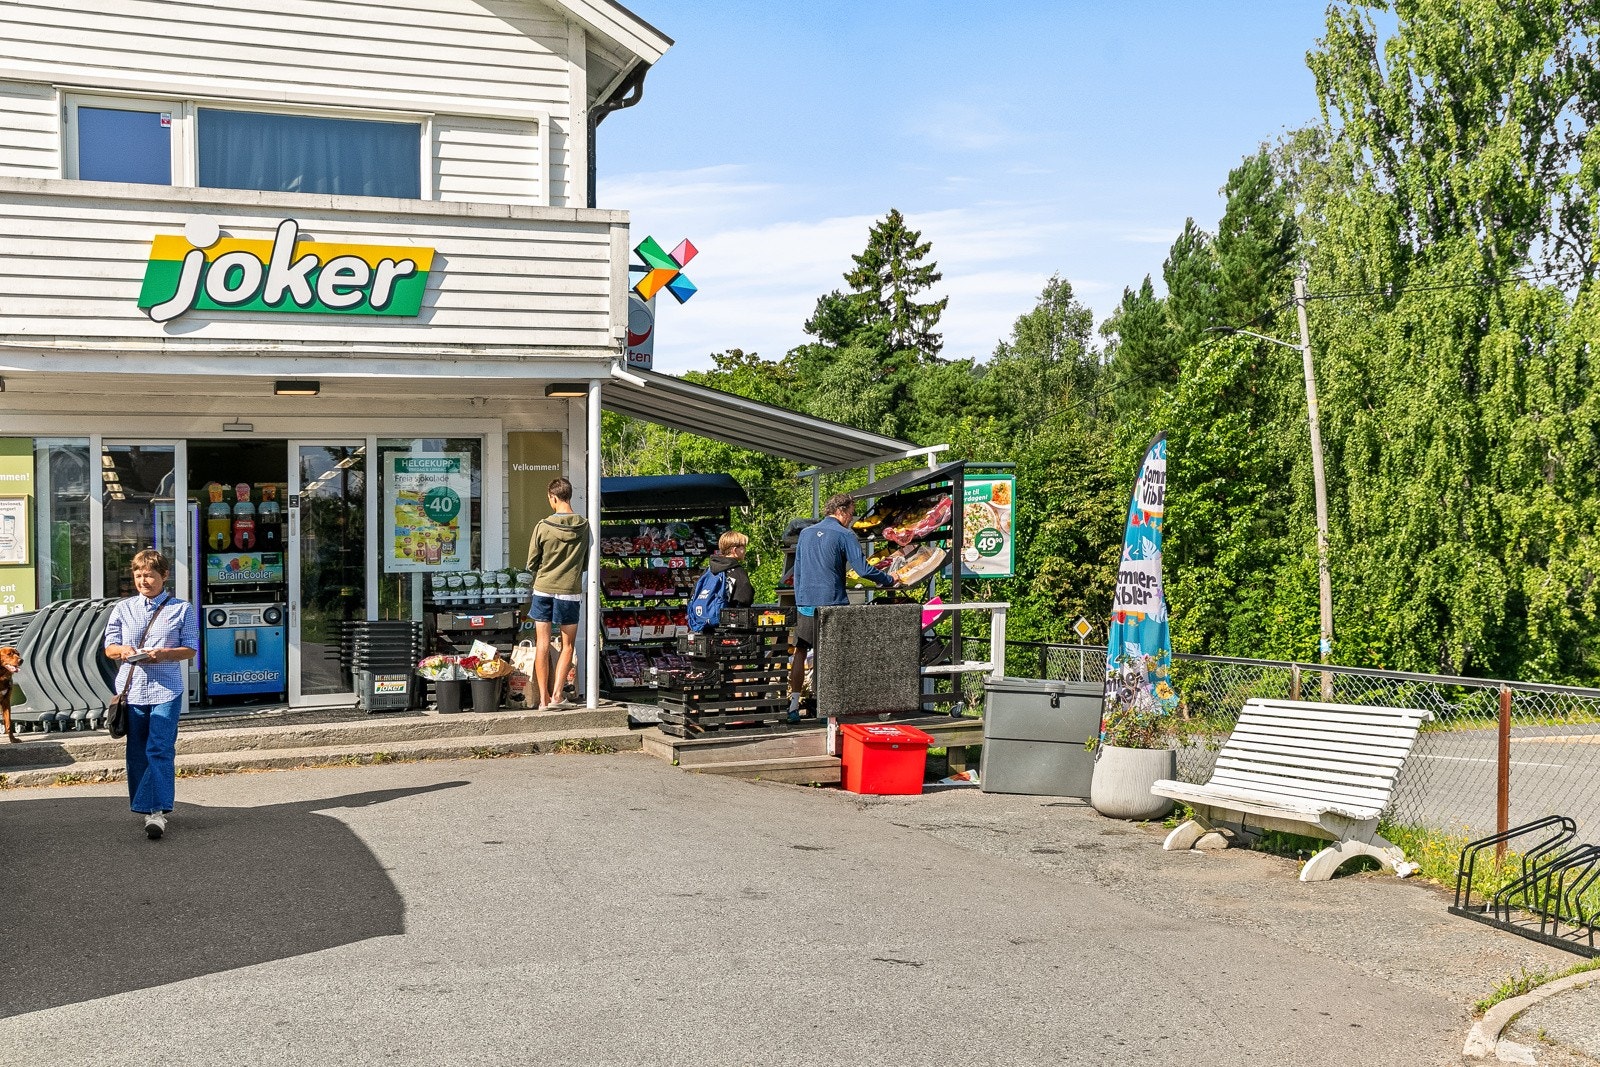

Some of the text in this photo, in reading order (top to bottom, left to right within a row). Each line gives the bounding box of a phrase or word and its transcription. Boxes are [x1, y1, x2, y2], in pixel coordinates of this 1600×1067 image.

[149, 214, 416, 322] joker
[629, 350, 651, 363] ten
[401, 459, 454, 468] HELGEKUPP
[512, 463, 560, 471] Velkommen!
[394, 474, 450, 484] Freia sjokolade
[218, 570, 273, 580] BrainCooler
[3, 594, 15, 603] 20
[212, 670, 279, 684] BrainCooler
[376, 682, 402, 693] joker
